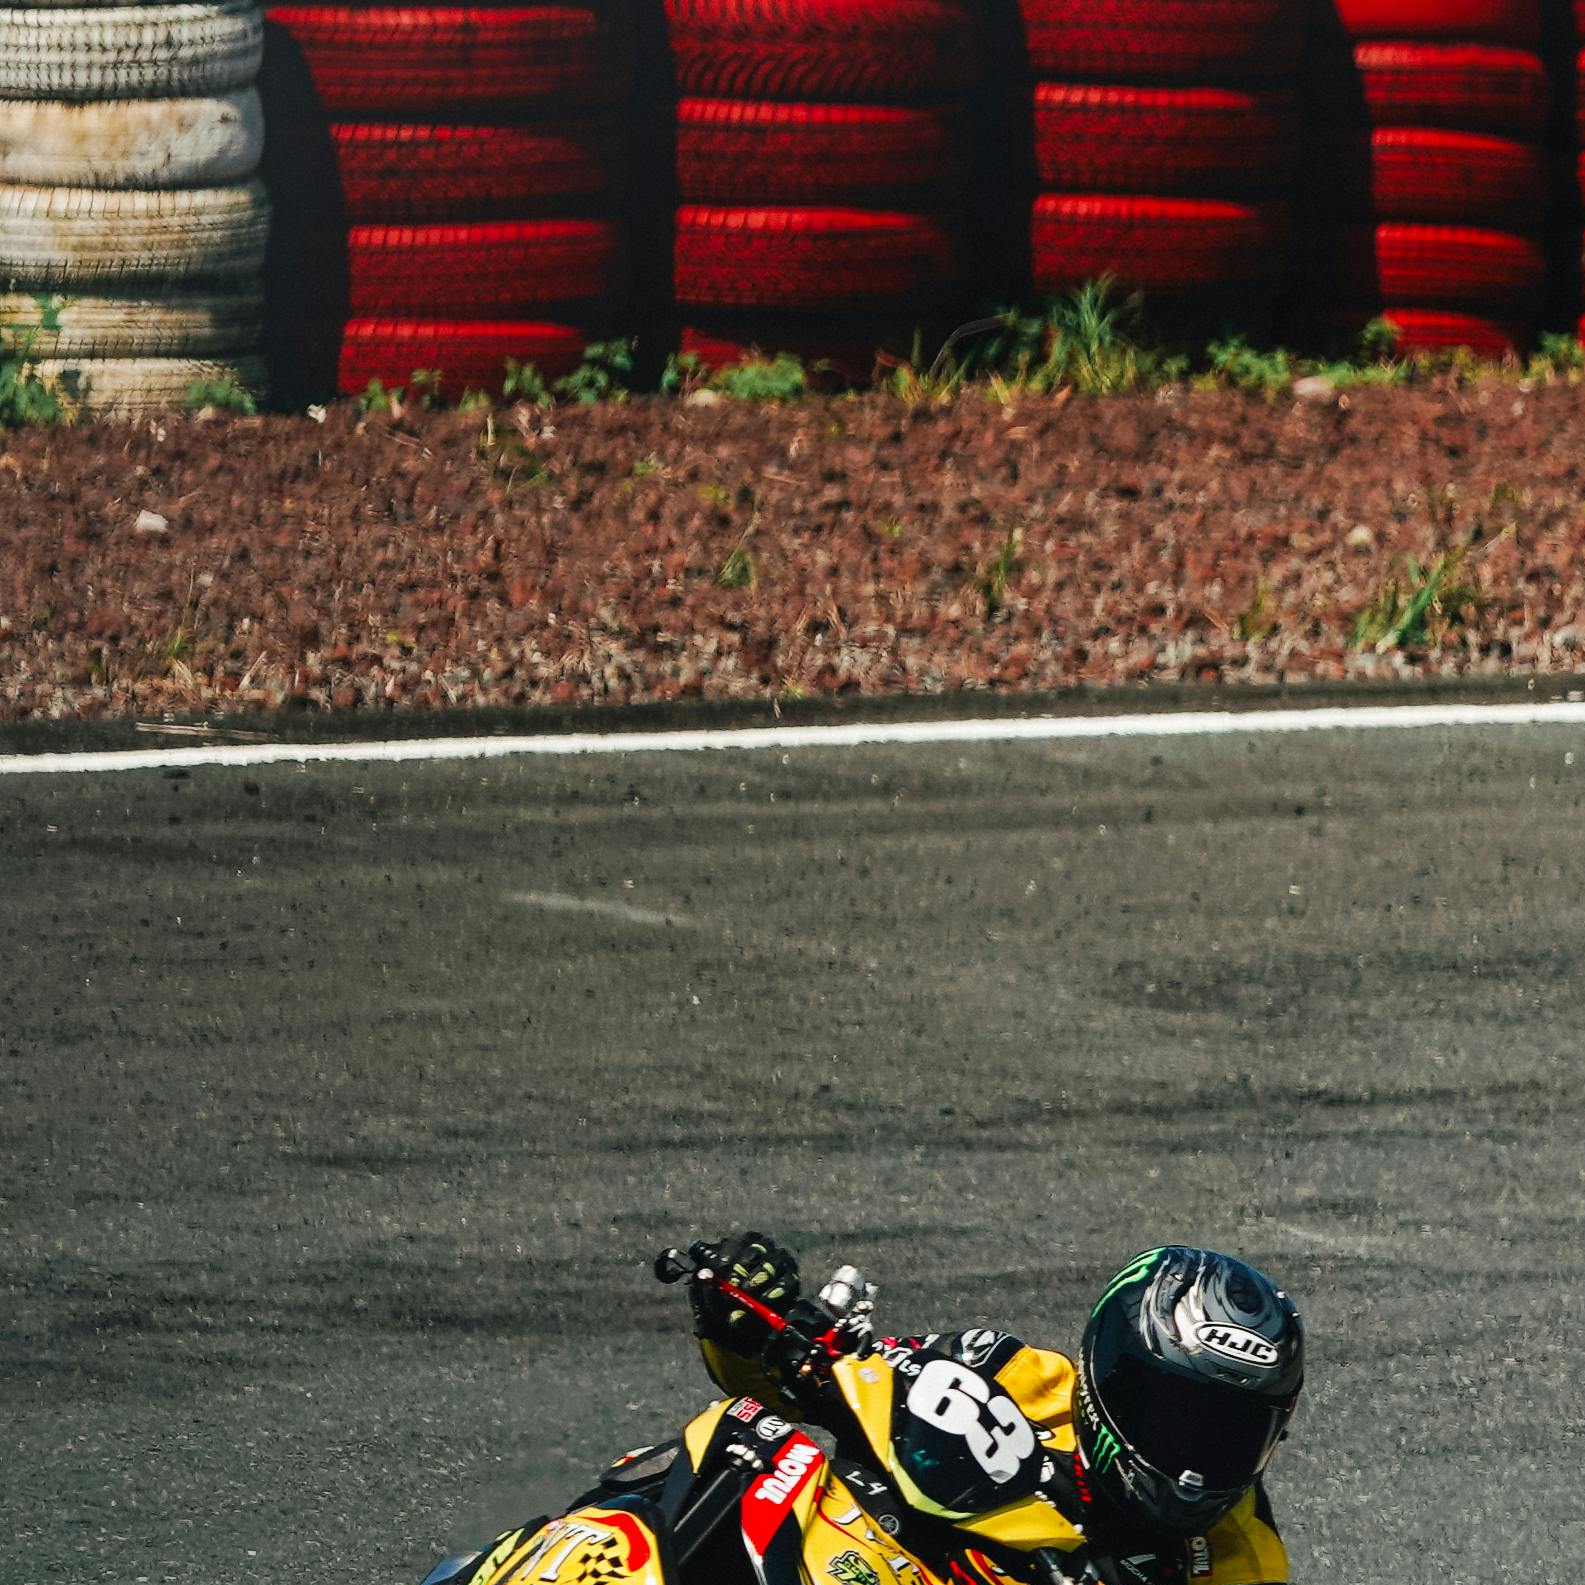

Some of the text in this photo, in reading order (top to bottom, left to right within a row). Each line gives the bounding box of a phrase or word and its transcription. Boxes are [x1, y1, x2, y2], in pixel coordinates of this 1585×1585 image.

[1204, 1329, 1273, 1361] HJC
[906, 1359, 1036, 1484] 63
[754, 1443, 821, 1505] MOTUL
